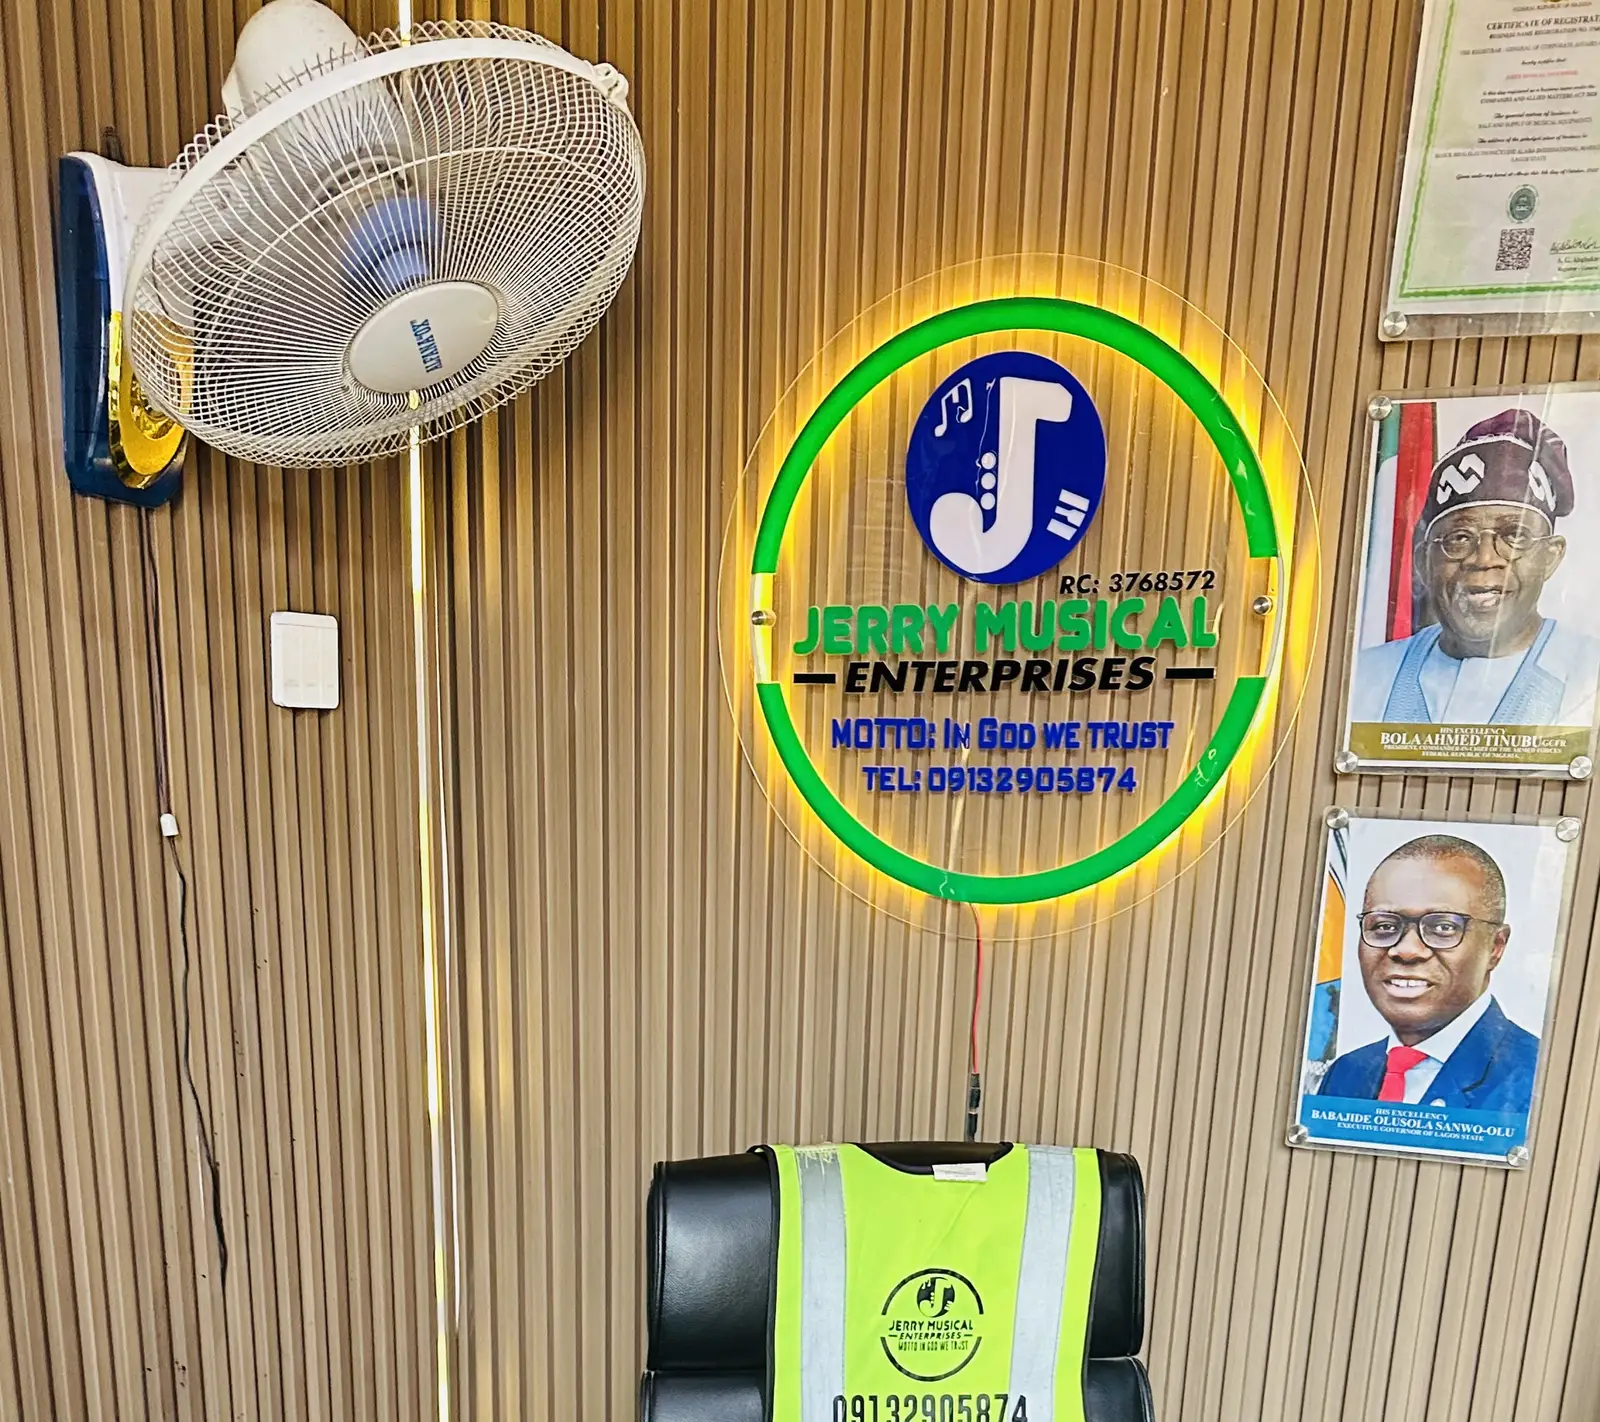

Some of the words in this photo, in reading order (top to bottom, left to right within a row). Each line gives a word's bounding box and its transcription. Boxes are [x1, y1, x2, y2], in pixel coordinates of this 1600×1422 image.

[1486, 20, 1539, 31] CERTIFICATE
[1541, 17, 1552, 26] OF
[1553, 14, 1600, 25] REGISTRAT
[1060, 573, 1099, 595] RC:
[1109, 570, 1215, 594] 3768572
[793, 602, 959, 657] JERRY
[976, 594, 1220, 655] MUSICAL
[844, 655, 1156, 694] ENTERPRISES
[831, 718, 935, 749] MOTTO:
[1043, 722, 1080, 748] WE
[1088, 722, 1174, 748] TRUST
[1380, 732, 1422, 745] BOLA
[1424, 733, 1481, 747] AHMED
[1484, 735, 1543, 748] TINUBU
[927, 767, 1136, 793] 09132905874
[1311, 1109, 1372, 1124] BABAJIDE
[1373, 1115, 1433, 1130] OLUSOLA
[1435, 1121, 1516, 1138] SANWO-OLU
[1375, 1107, 1390, 1115] HIS
[1391, 1109, 1449, 1121] EXCELLENCY
[1337, 1122, 1380, 1132] EXECUTIVE
[1380, 1125, 1421, 1136] GOVERNOR
[1434, 1131, 1460, 1140] LAGOS
[1461, 1134, 1484, 1142] STATE
[889, 1319, 924, 1331] JERRY
[927, 1319, 973, 1331] MUSICAL
[898, 1341, 917, 1351] MOTTO
[940, 1341, 949, 1351] WE
[899, 1332, 961, 1340] ENTERPRISES
